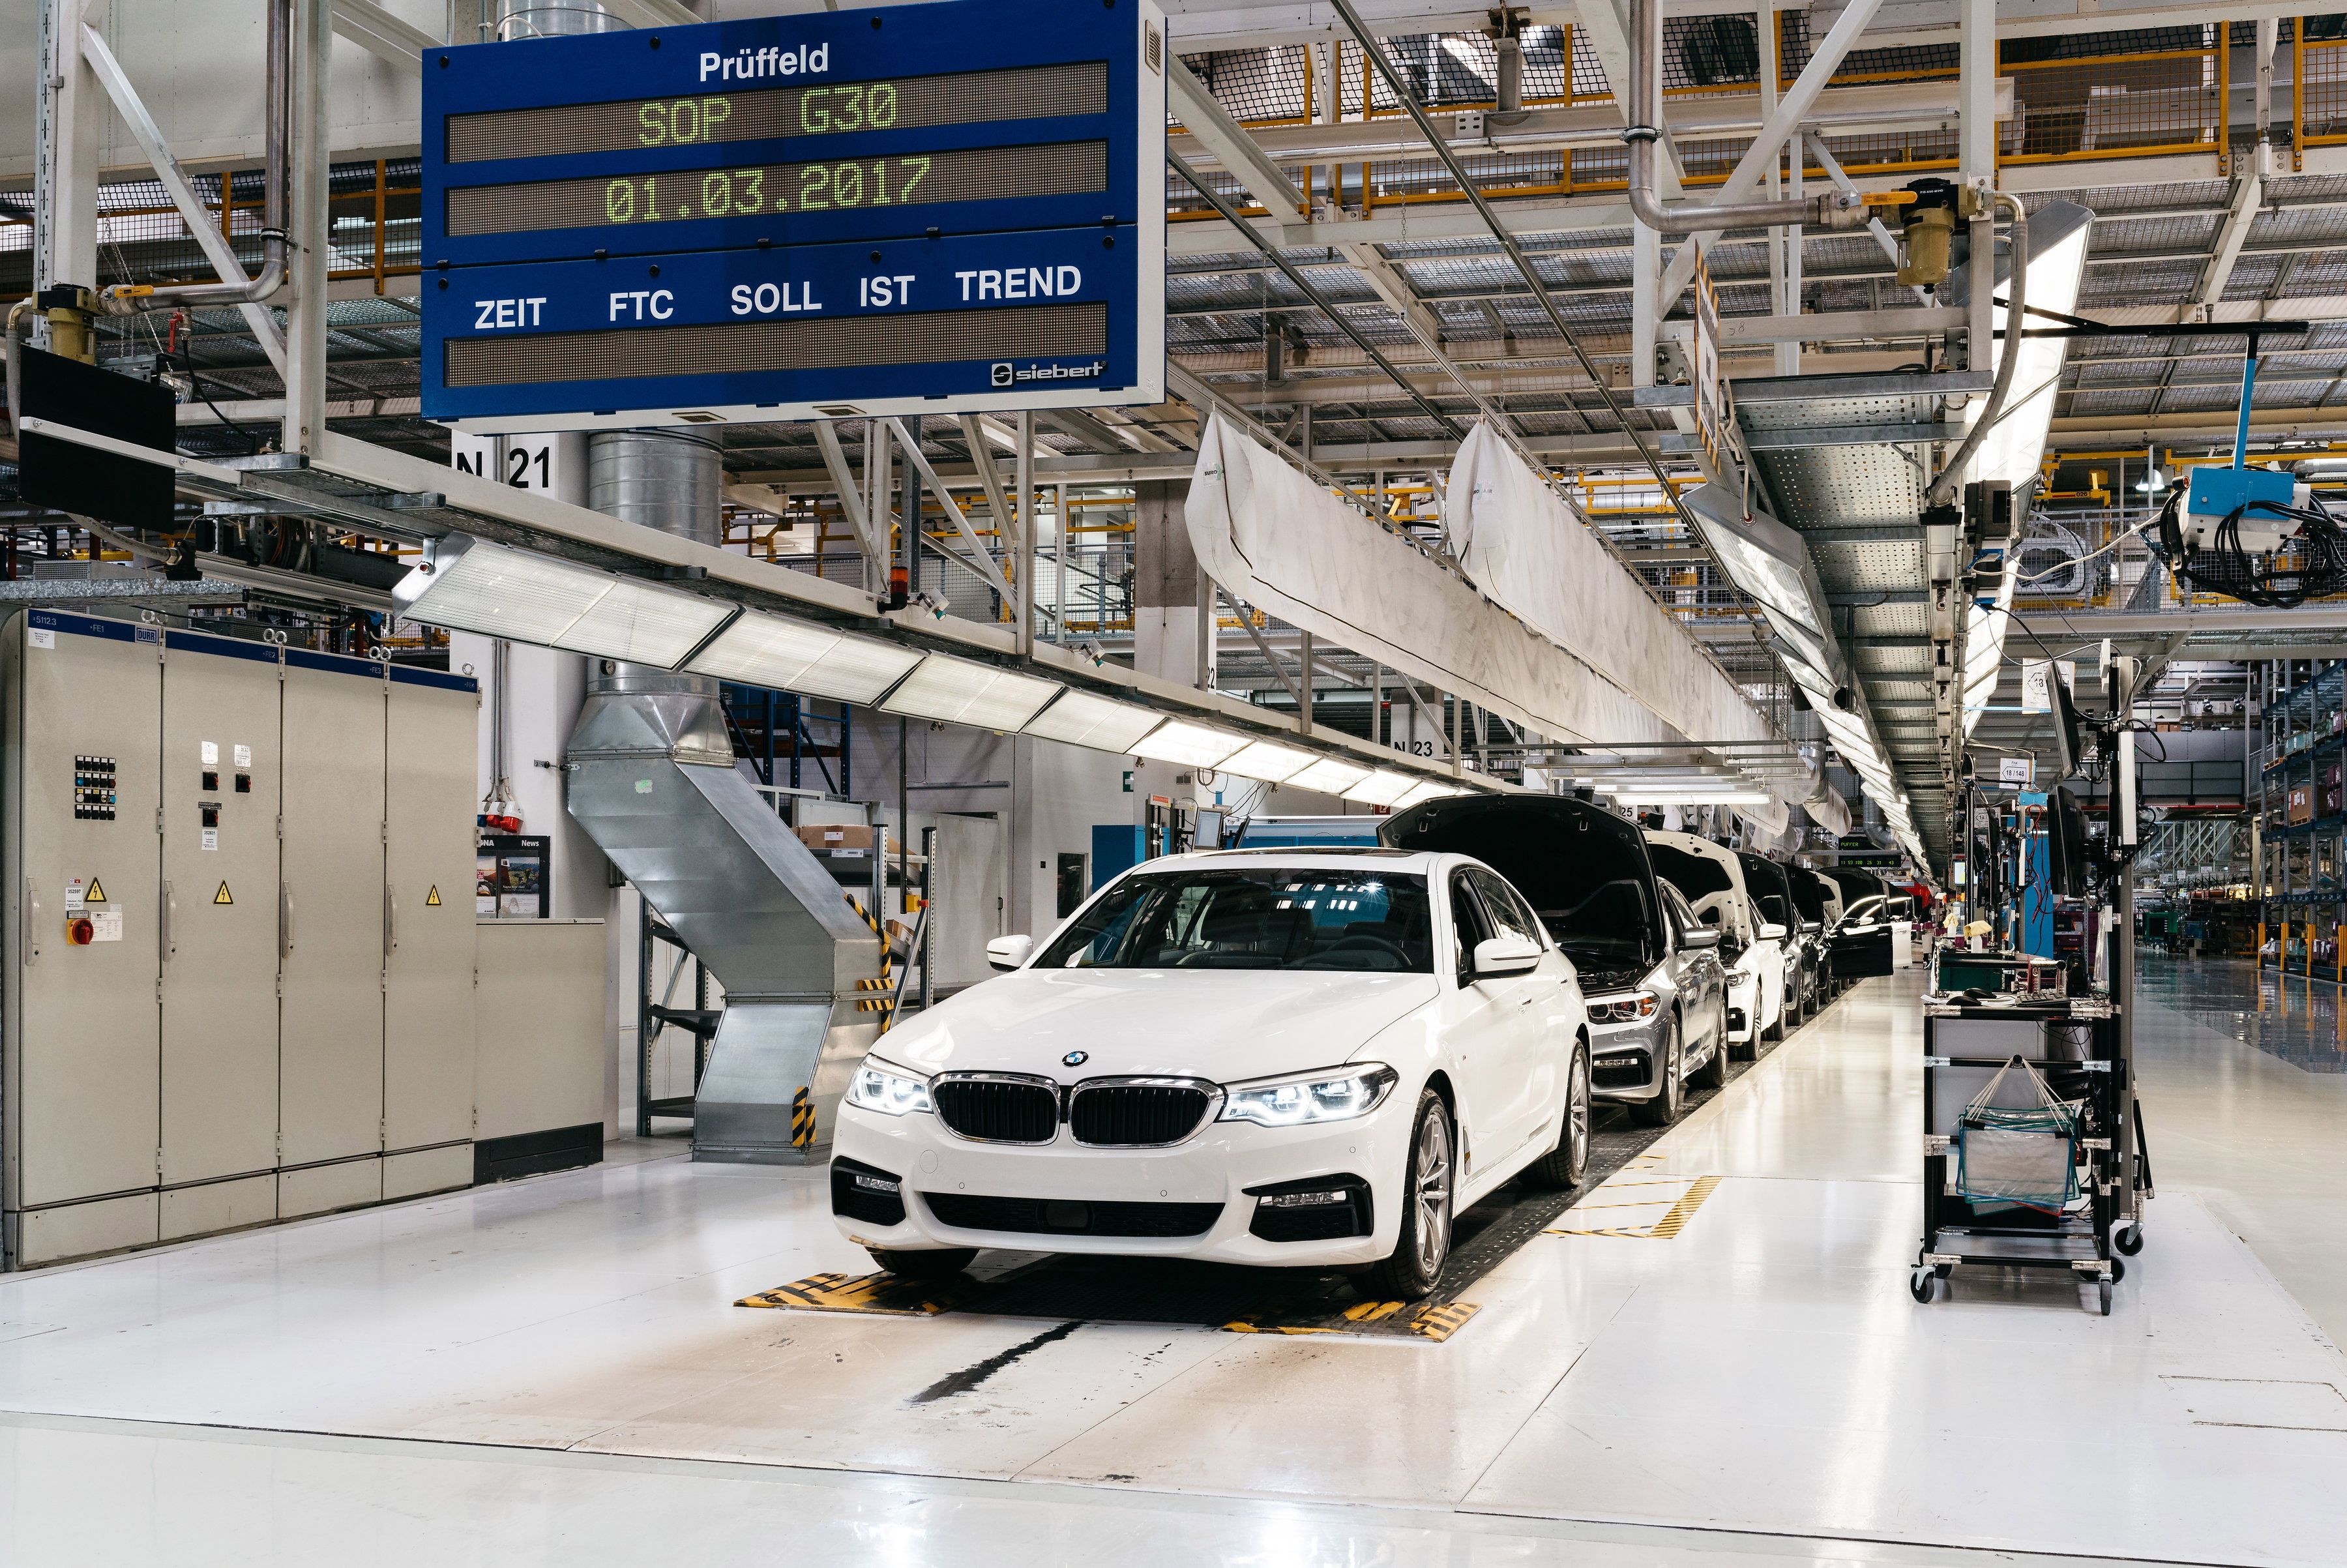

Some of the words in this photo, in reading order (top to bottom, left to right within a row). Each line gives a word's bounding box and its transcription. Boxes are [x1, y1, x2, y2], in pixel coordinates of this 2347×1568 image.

[701, 43, 828, 81] Prüffeld
[639, 97, 730, 145] SOP
[801, 84, 896, 132] G30
[606, 157, 930, 222] 01.03.2017
[475, 298, 546, 329] ZEIT
[610, 290, 673, 321] FTC
[731, 281, 821, 315] SOLL
[861, 275, 915, 306] IST
[955, 265, 1082, 300] TREND
[1016, 362, 1103, 380] siebert
[457, 451, 482, 477] N
[509, 447, 550, 488] 21
[138, 628, 156, 642] DÜRR
[1395, 741, 1406, 752] N
[1414, 741, 1432, 757] 23
[1621, 807, 1632, 817] 25
